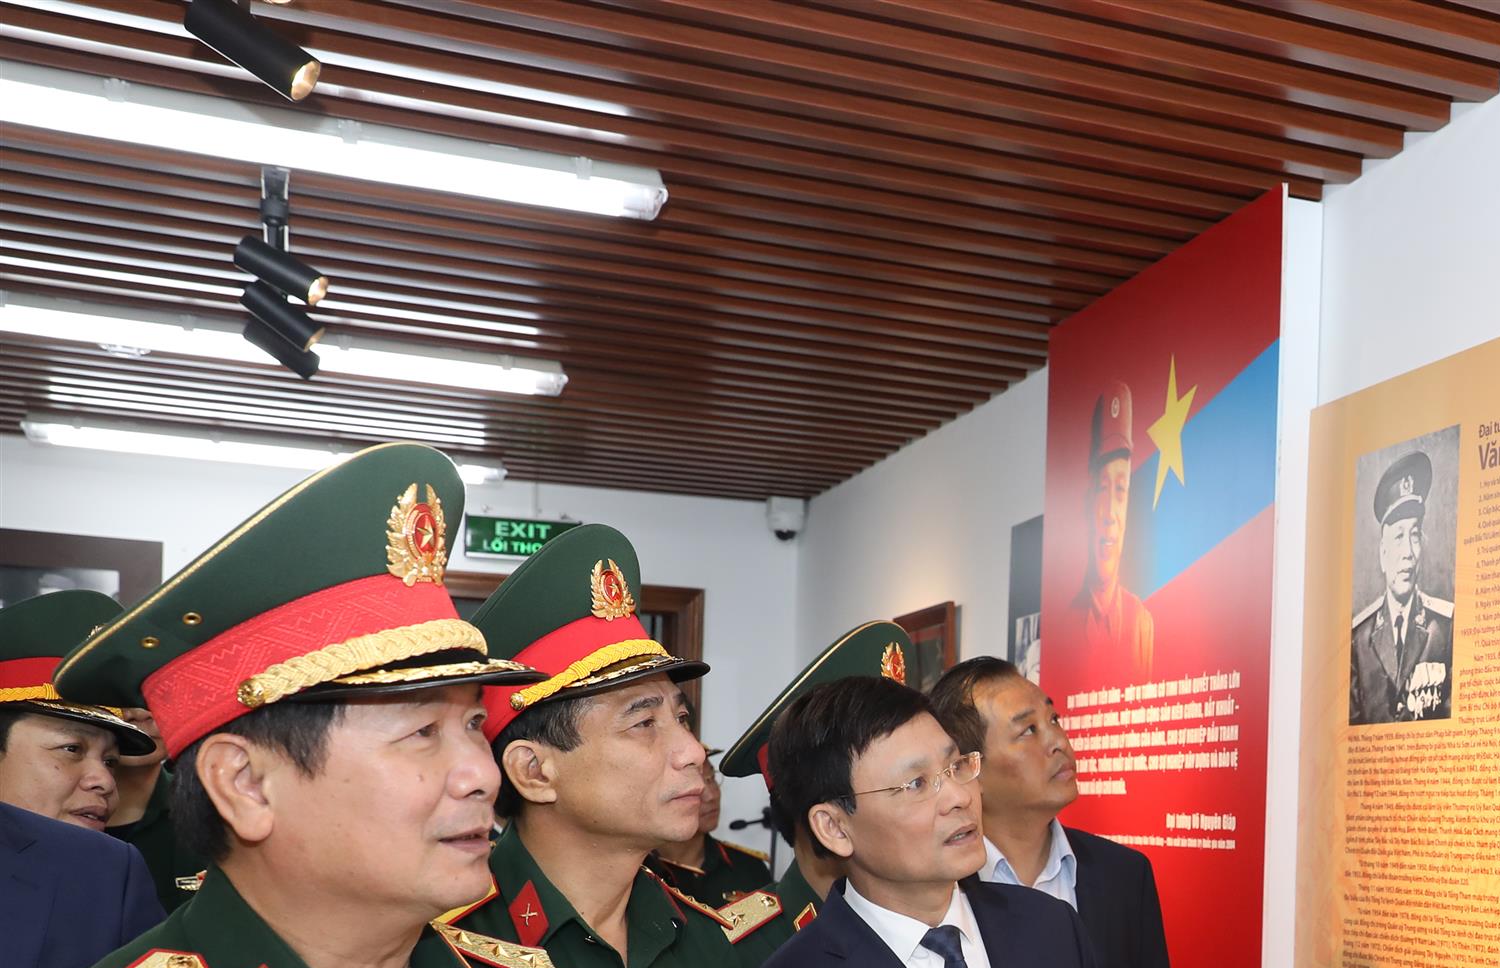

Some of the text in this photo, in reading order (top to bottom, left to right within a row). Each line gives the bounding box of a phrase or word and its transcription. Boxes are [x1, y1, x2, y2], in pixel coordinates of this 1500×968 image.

[1478, 422, 1492, 440] Đại
[495, 521, 551, 539] EXIT
[512, 541, 543, 553] THO
